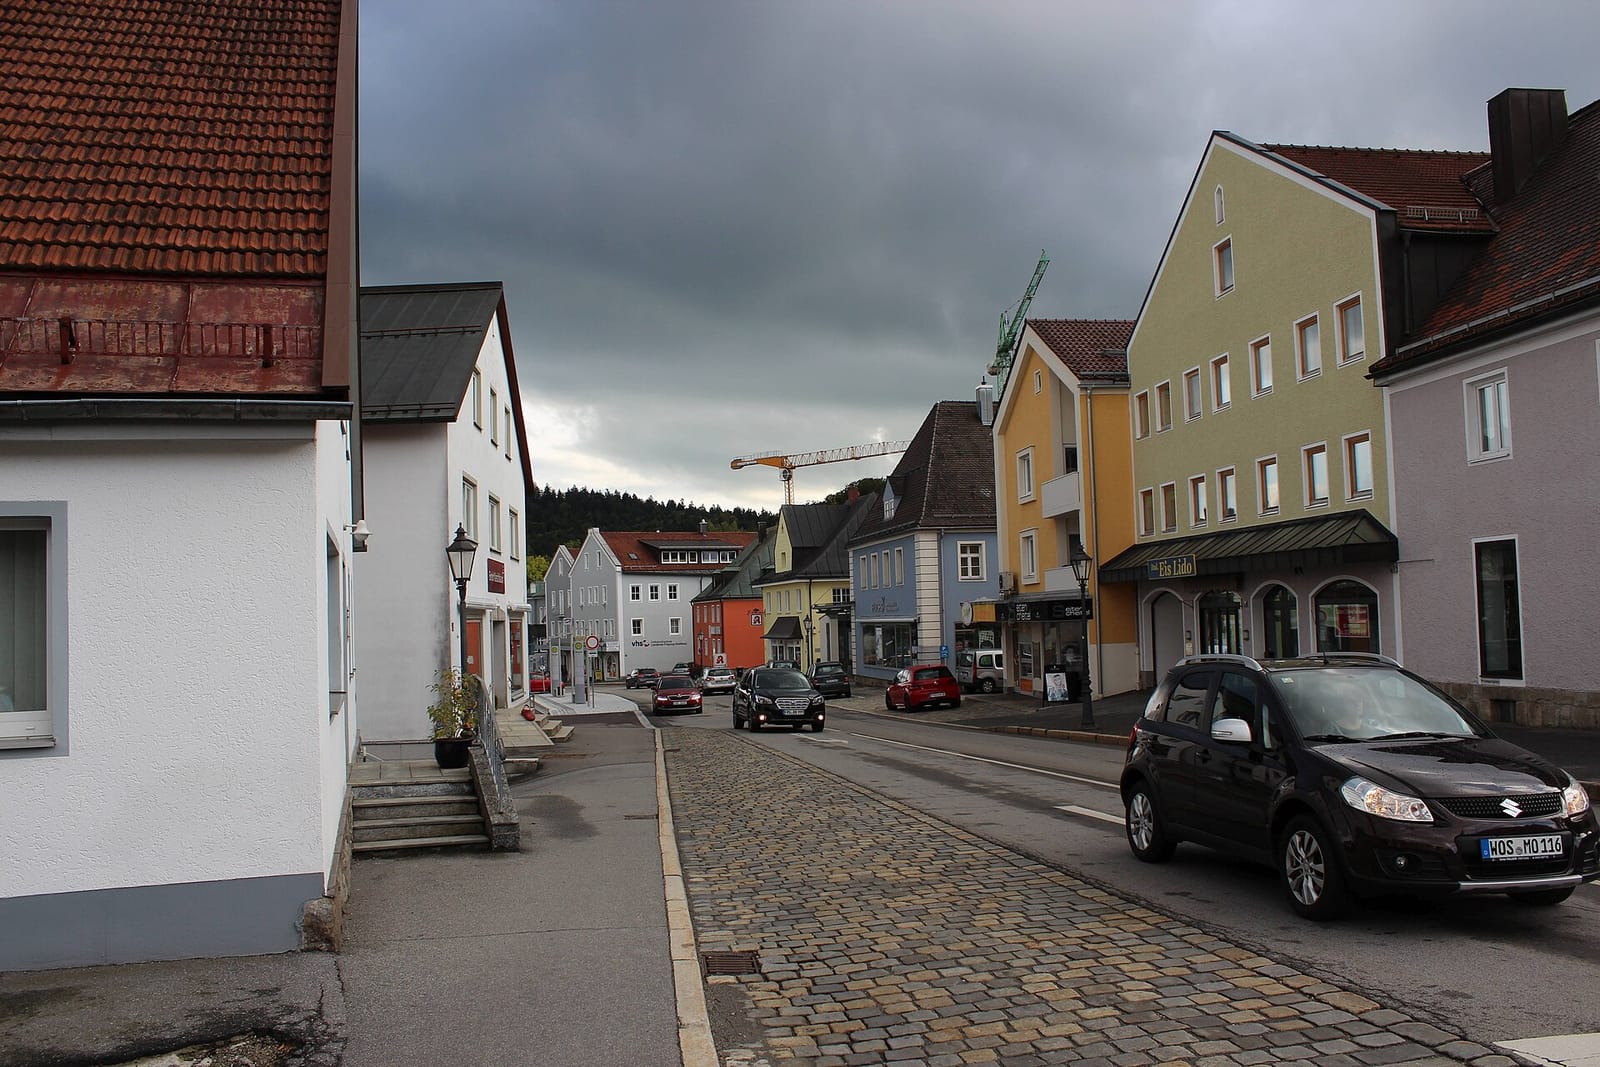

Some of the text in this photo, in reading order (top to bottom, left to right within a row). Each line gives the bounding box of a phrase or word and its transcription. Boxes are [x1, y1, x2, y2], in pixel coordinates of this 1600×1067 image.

[1159, 560, 1172, 577] Eis
[1173, 558, 1192, 576] Lido
[1490, 840, 1514, 856] WOS
[1523, 838, 1539, 854] MO
[1540, 837, 1562, 853] 116
